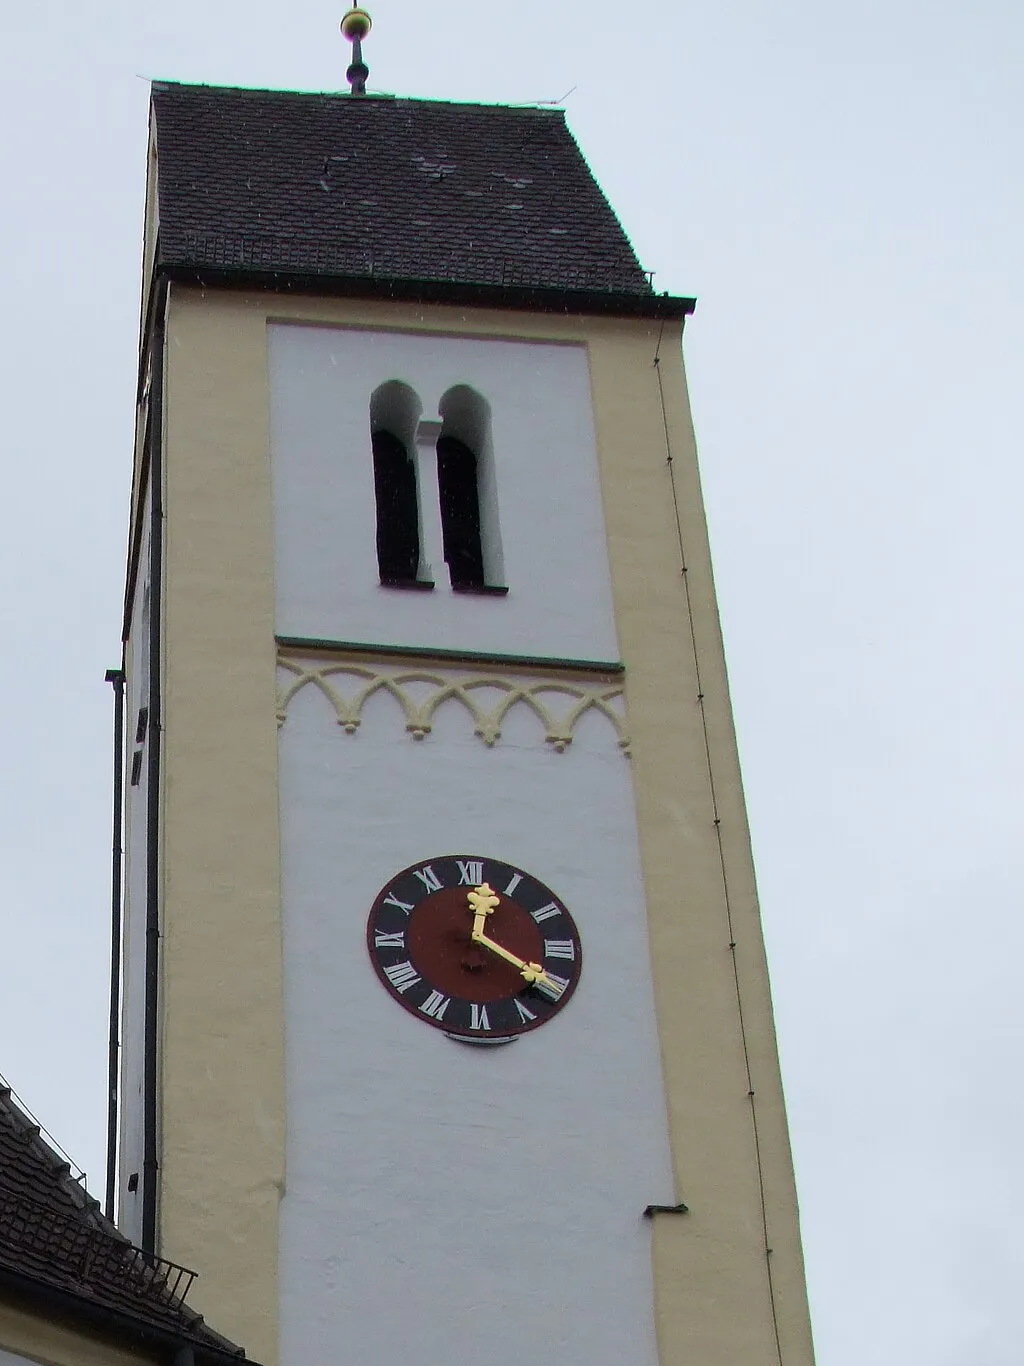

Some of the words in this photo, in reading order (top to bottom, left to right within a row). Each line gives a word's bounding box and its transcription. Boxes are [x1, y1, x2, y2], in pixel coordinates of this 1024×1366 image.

[413, 866, 444, 894] XI
[456, 861, 484, 886] XII
[503, 873, 523, 897] I
[383, 892, 414, 916] X
[530, 901, 562, 924] II
[375, 929, 404, 948] IX
[544, 939, 575, 961] III
[383, 961, 422, 994] VIII
[418, 990, 451, 1020] VII
[469, 1003, 491, 1030] VI
[513, 998, 537, 1024] V
